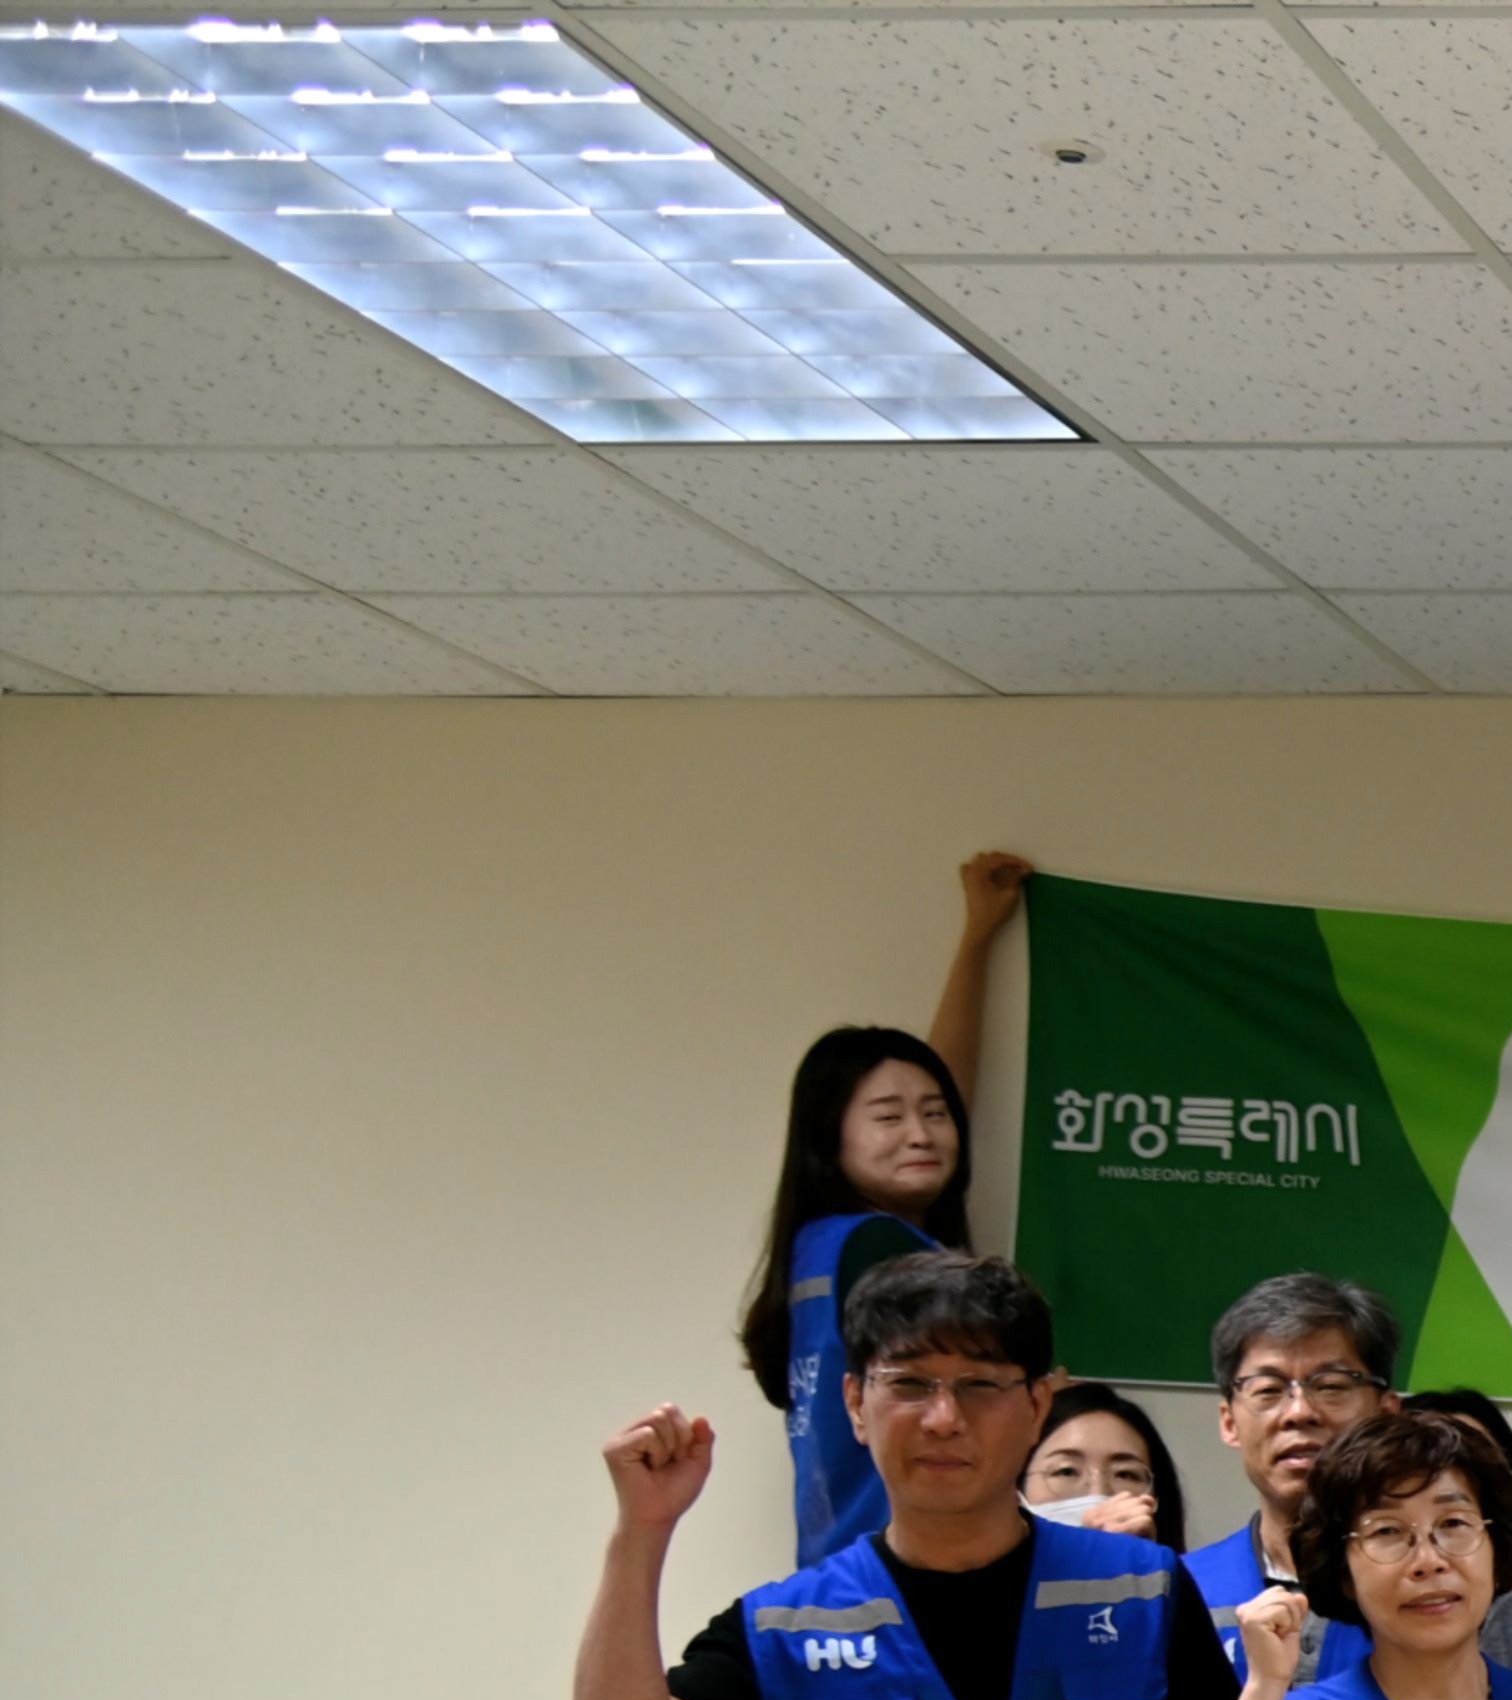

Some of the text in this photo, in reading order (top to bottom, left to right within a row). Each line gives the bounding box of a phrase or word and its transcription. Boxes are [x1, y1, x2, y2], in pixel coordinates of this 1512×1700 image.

[1052, 1089, 1361, 1166] 화성특례시
[1098, 1165, 1321, 1190] HWASEONG SPECIAL CITY
[804, 1635, 876, 1671] HU
